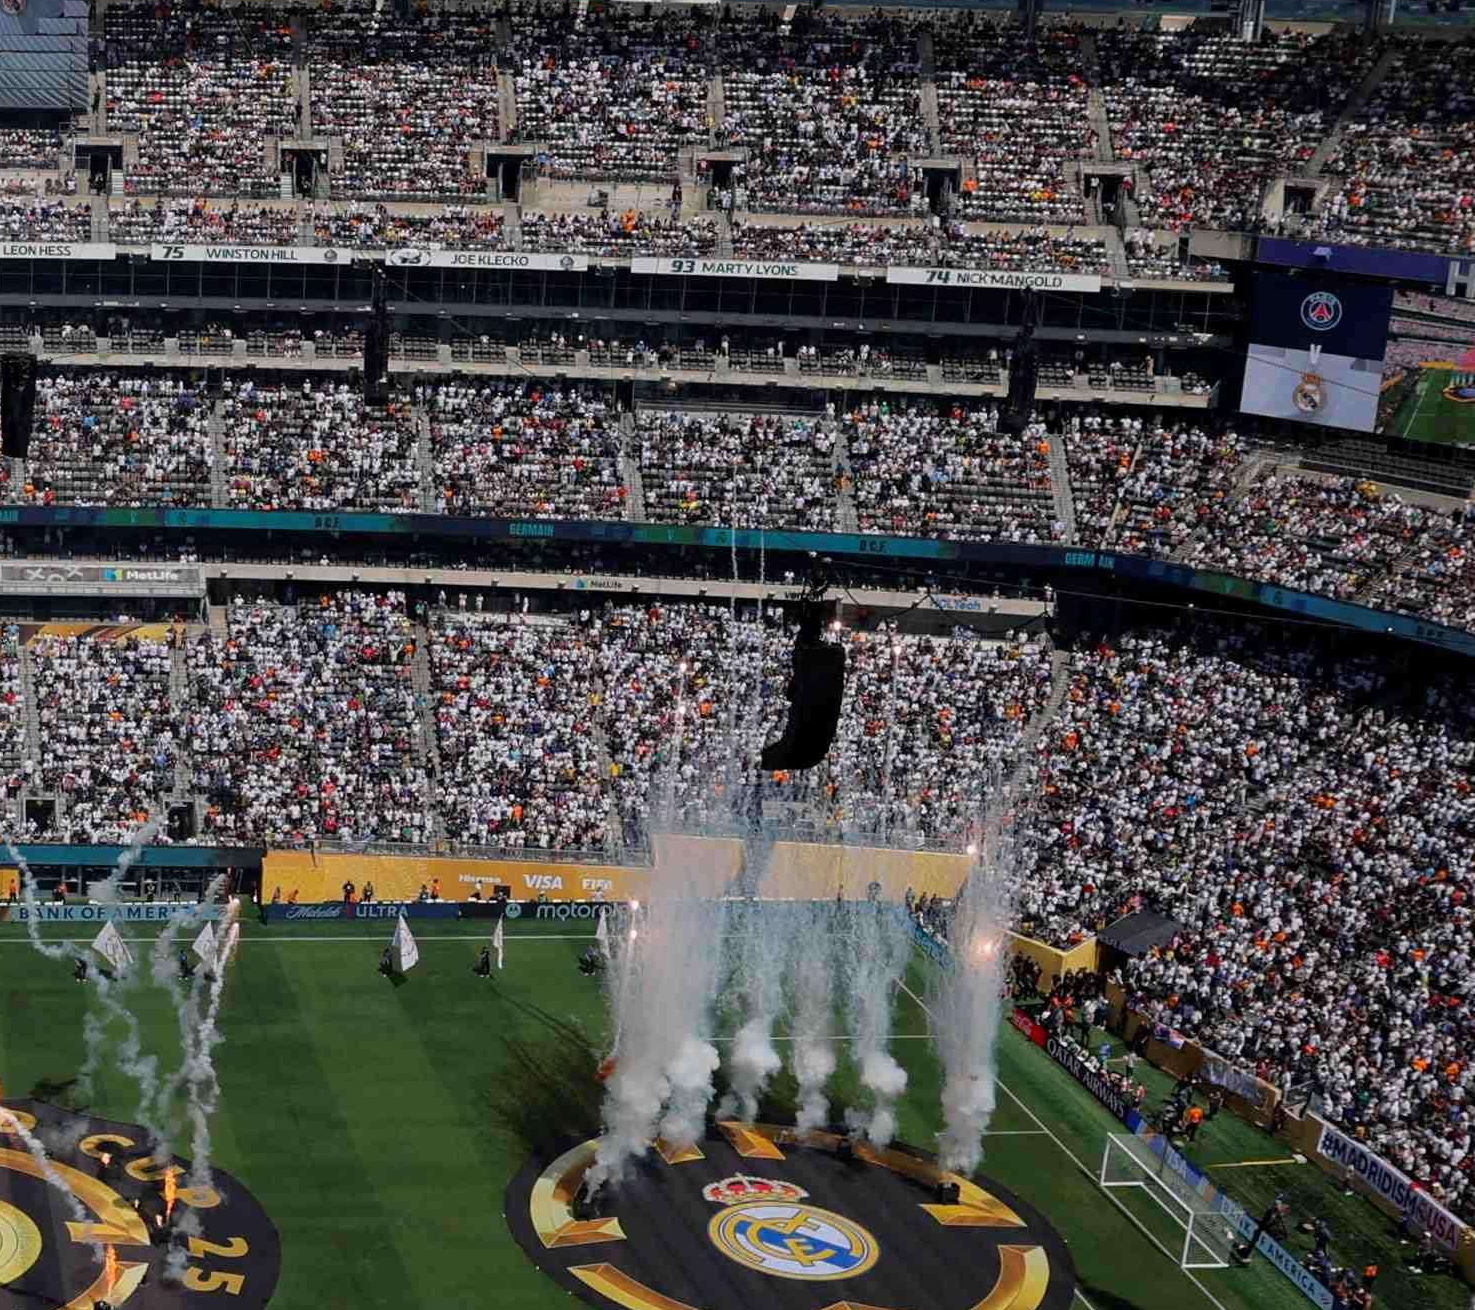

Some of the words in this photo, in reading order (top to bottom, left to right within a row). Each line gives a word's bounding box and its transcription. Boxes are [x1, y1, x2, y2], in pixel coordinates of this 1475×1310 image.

[2, 245, 37, 257] LEON
[39, 245, 72, 257] HESS
[162, 246, 185, 259] 75
[206, 248, 267, 260] WINSTON
[270, 248, 298, 261] HILL
[451, 253, 474, 266] JOE
[476, 254, 530, 268] KLECKO
[670, 259, 696, 273] 93
[702, 261, 754, 276] MARTY
[756, 263, 798, 277] LYONS
[925, 269, 951, 284] 74
[956, 272, 987, 285] NICK
[990, 272, 1064, 289] MANGOLD
[508, 523, 555, 537] GERMAIN
[125, 570, 180, 581] MetLife
[523, 873, 564, 890] VISA
[80, 907, 106, 920] OF
[355, 904, 410, 919] ULTRA
[1265, 1242, 1318, 1298] AMERICA
